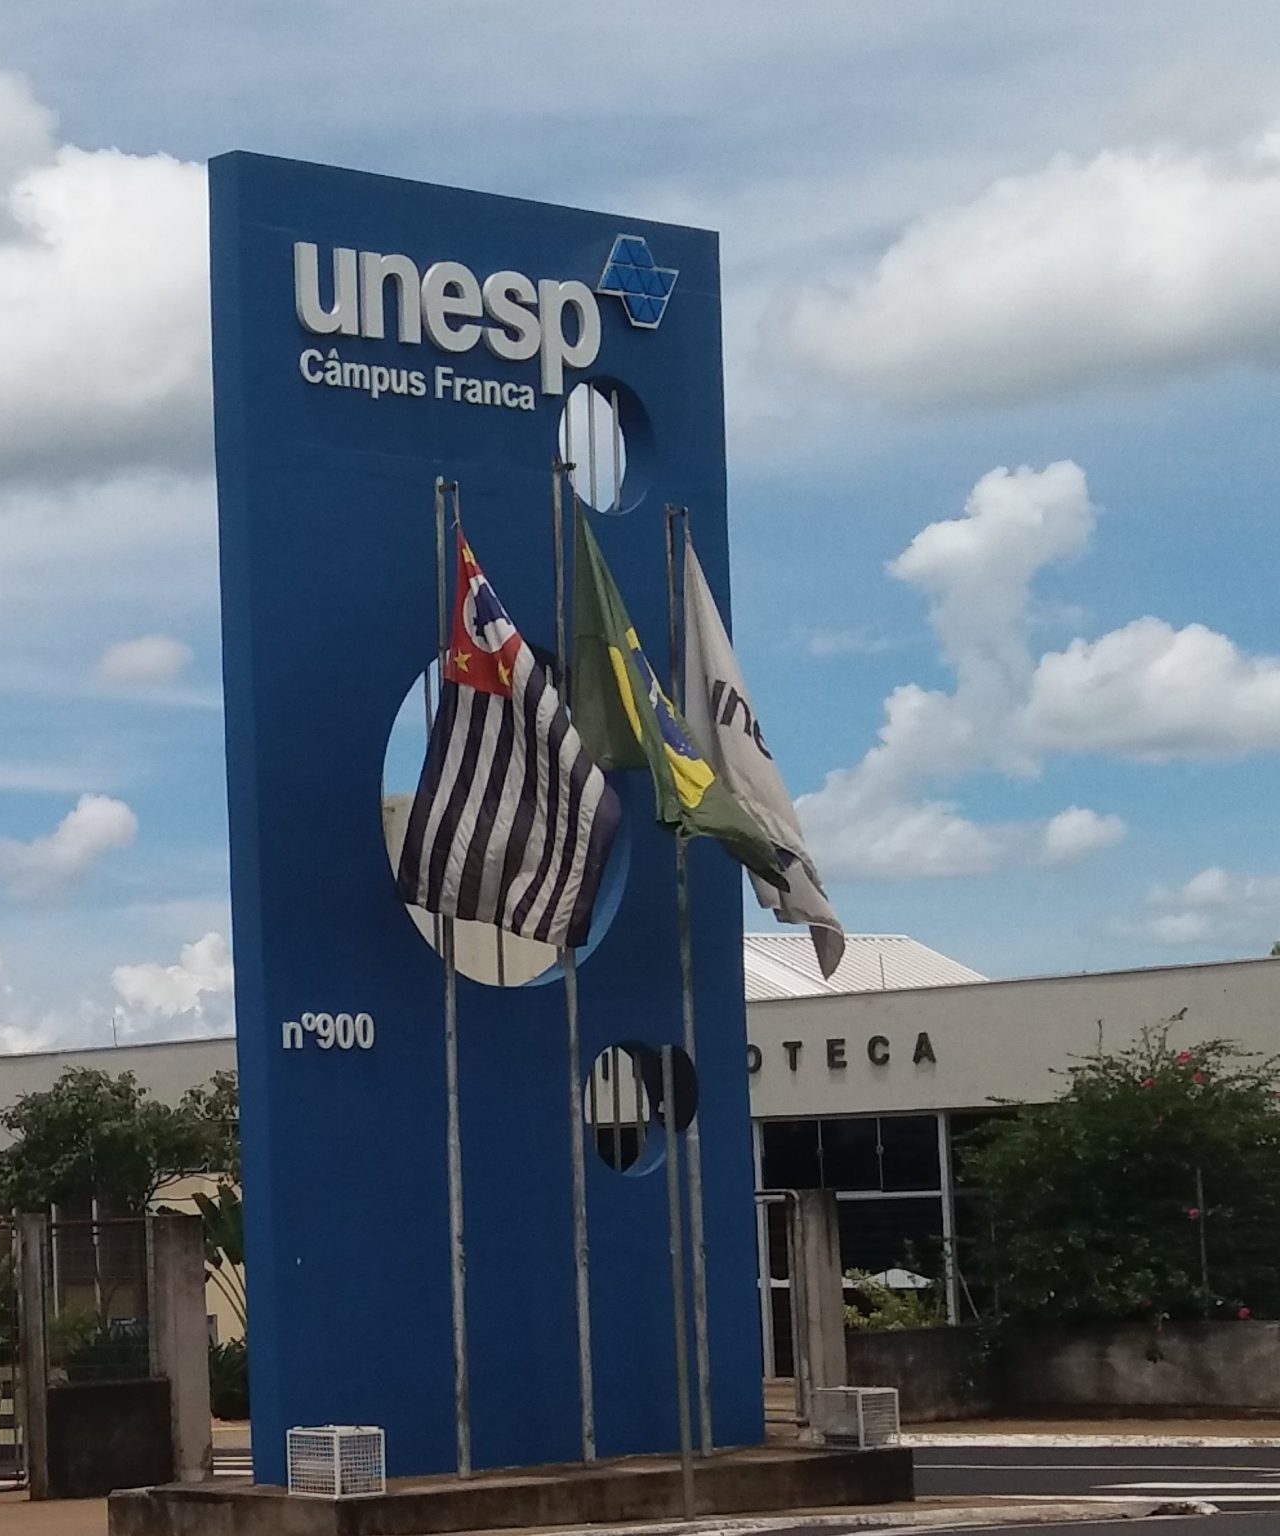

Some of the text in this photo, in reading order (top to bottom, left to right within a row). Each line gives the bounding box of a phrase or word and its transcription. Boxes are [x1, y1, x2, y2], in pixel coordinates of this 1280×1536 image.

[293, 241, 602, 395] unesp
[300, 347, 536, 411] Câmpus Franca
